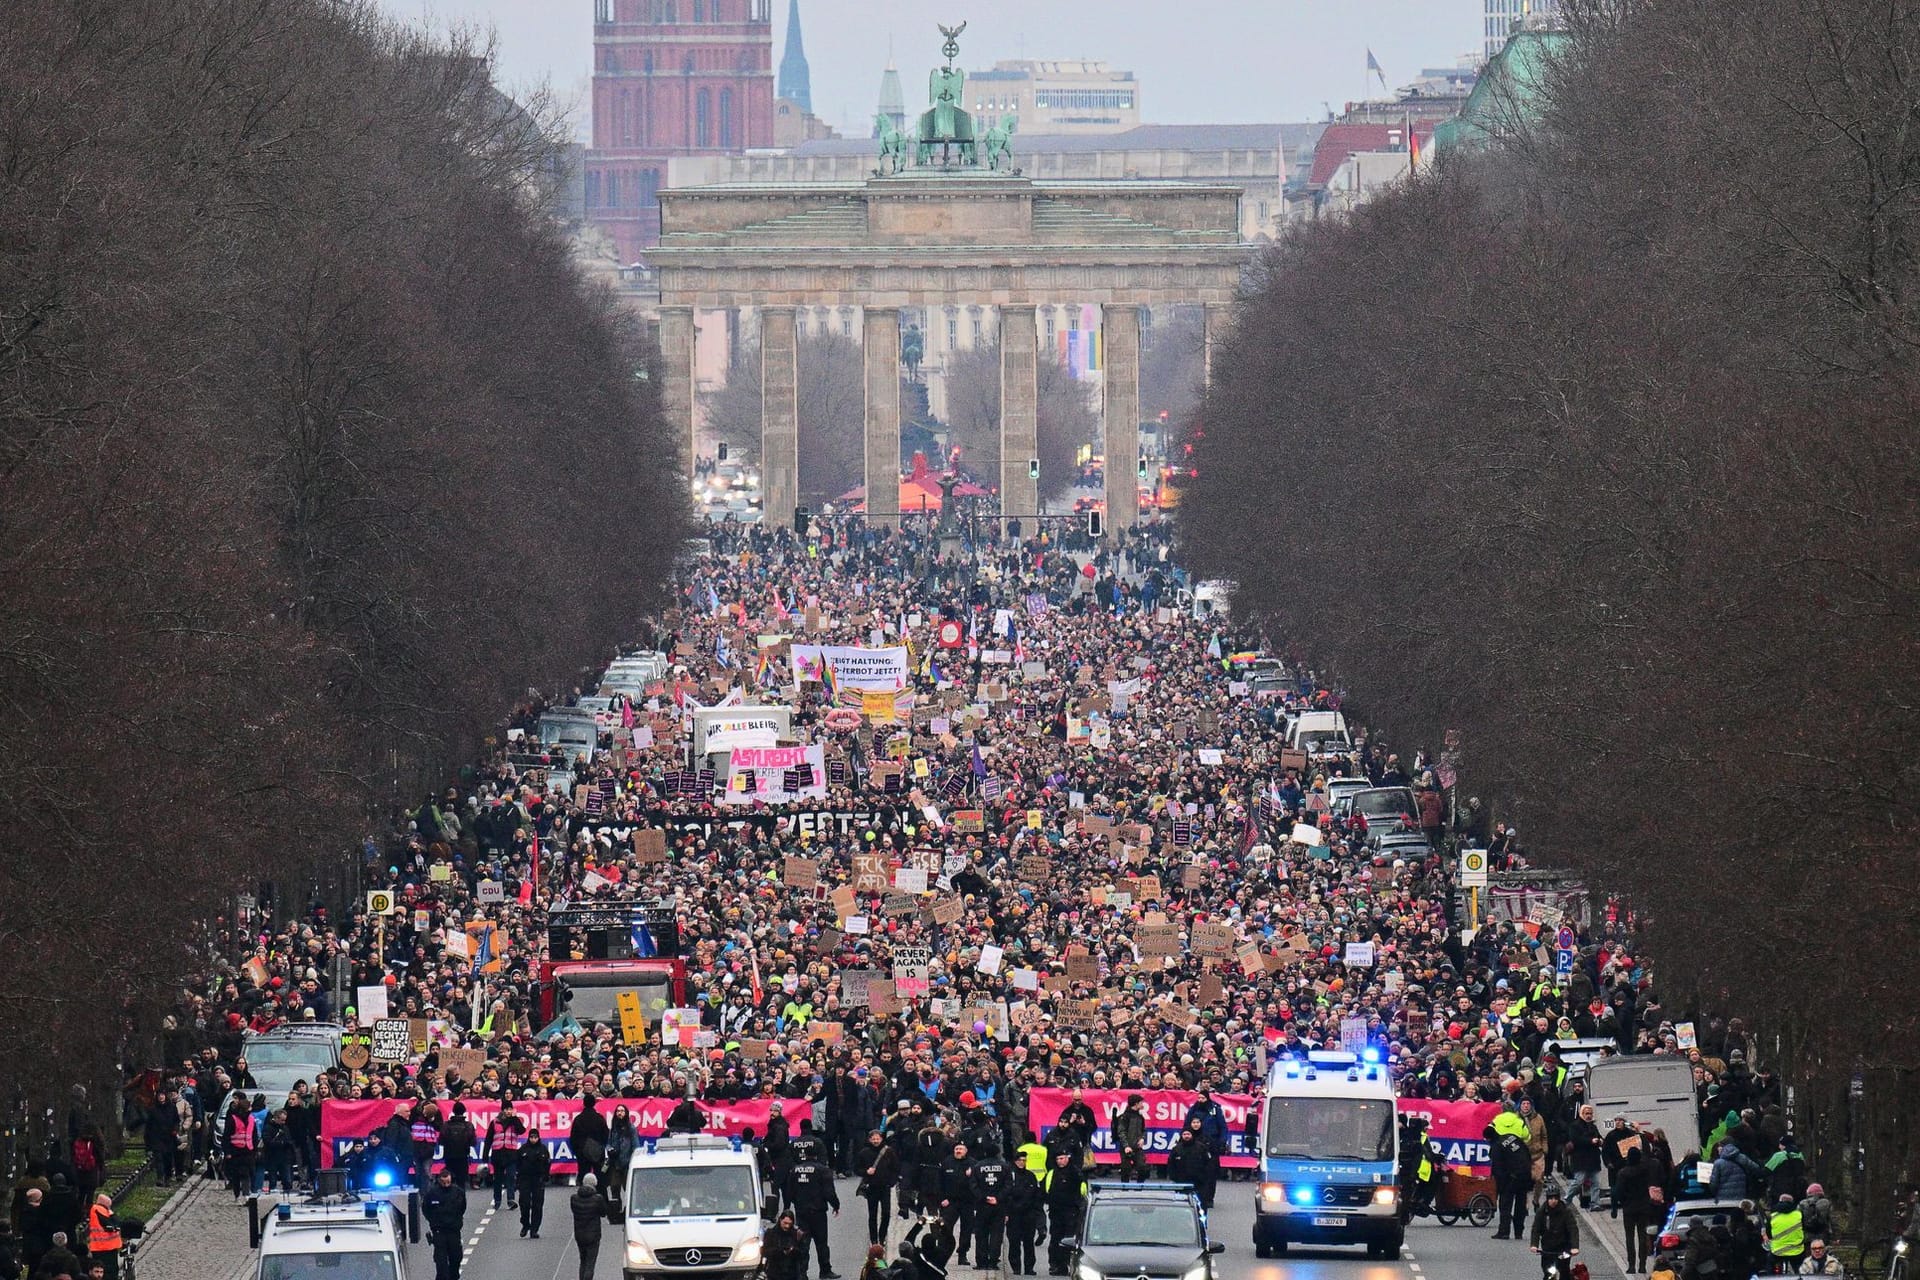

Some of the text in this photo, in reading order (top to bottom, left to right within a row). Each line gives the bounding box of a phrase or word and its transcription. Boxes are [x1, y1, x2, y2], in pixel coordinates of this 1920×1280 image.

[731, 746, 807, 767] ASYLRECHT
[1471, 858, 1478, 867] H
[482, 887, 500, 895] CDU
[376, 897, 385, 908] H
[894, 949, 925, 958] NEVER
[896, 959, 926, 967] AGAIN
[1560, 952, 1568, 970] P
[906, 969, 916, 978] IS
[897, 978, 928, 990] NOW
[376, 1020, 407, 1031] GEGEN
[342, 1036, 353, 1045] NO
[375, 1031, 409, 1044] RECHTS!
[1603, 1120, 1614, 1128] 100
[1447, 1142, 1490, 1162] AFD
[1298, 1166, 1362, 1174] POLIZEI
